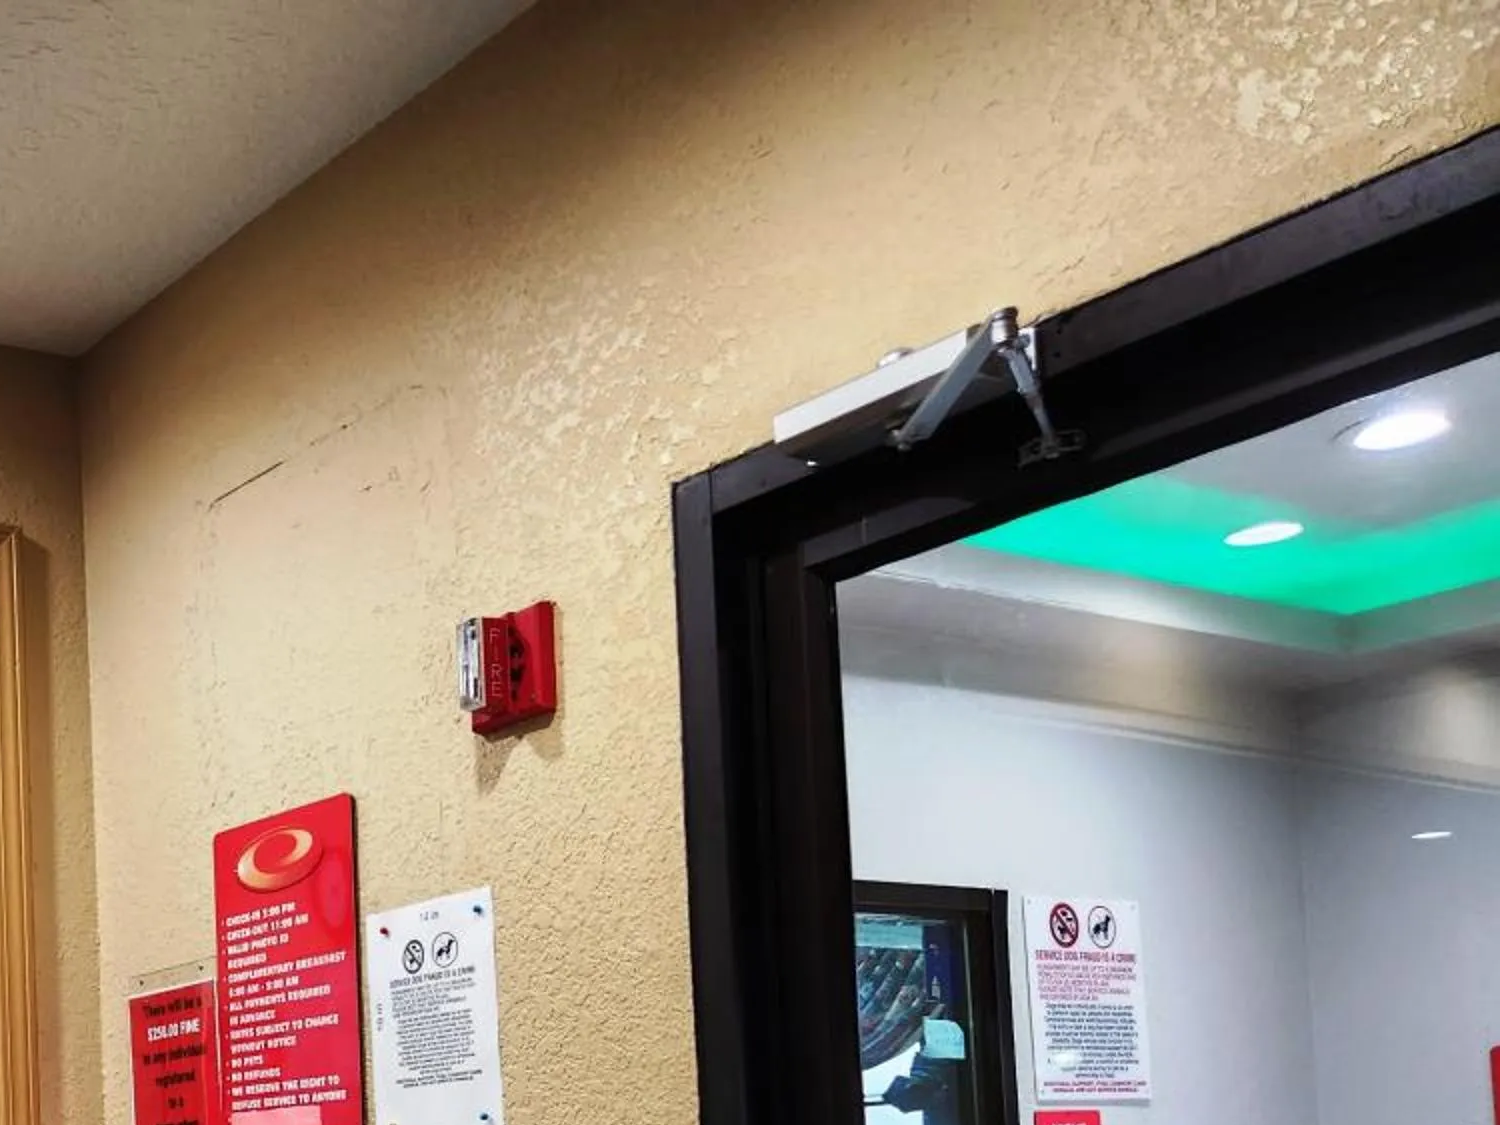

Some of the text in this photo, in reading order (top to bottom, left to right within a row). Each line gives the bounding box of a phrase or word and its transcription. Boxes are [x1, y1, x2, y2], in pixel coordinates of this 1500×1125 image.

[490, 627, 504, 697] FIRE
[251, 936, 278, 950] PHOTO
[295, 951, 346, 970] BREAKFAST
[255, 1021, 290, 1037] SUBJECT
[292, 1019, 303, 1031] TO
[305, 1013, 339, 1029] CHANGE
[328, 1075, 340, 1086] TO
[299, 1093, 310, 1104] TO
